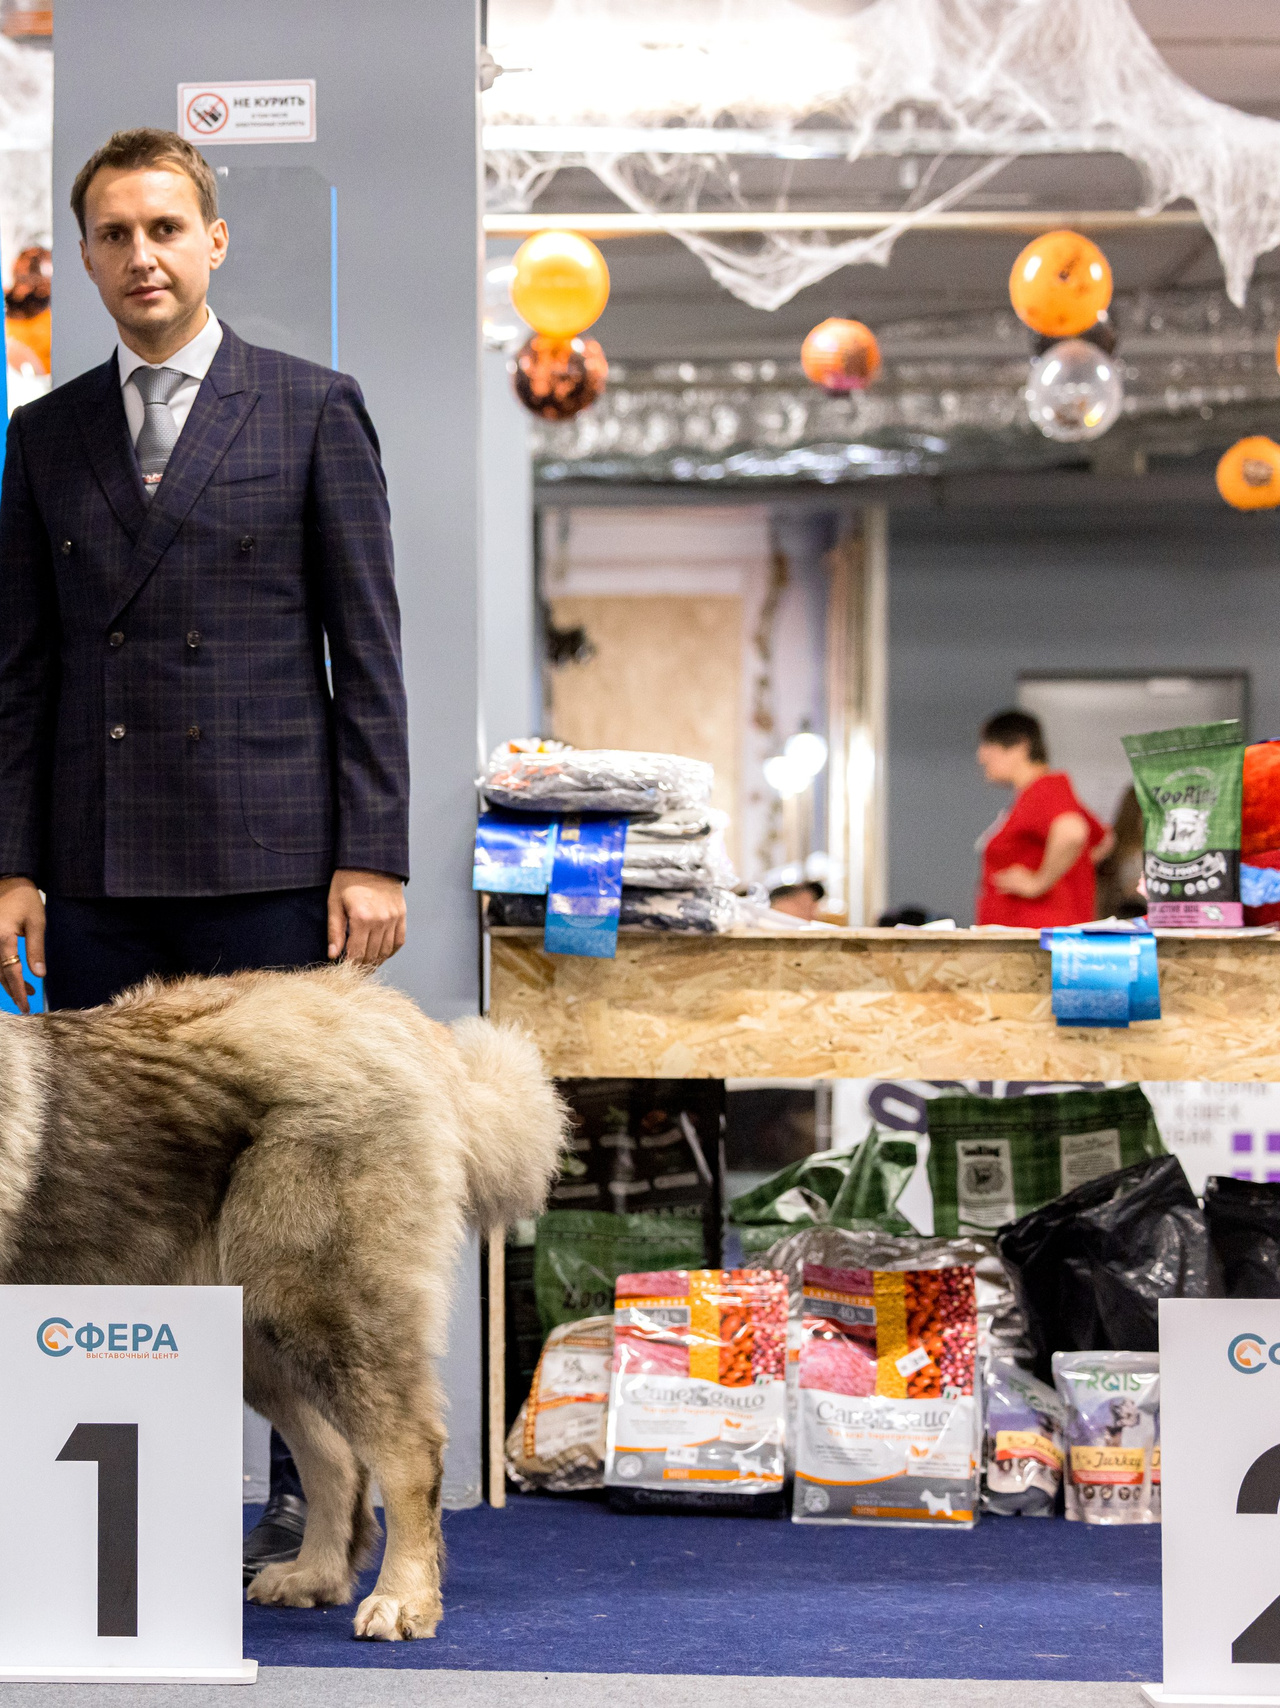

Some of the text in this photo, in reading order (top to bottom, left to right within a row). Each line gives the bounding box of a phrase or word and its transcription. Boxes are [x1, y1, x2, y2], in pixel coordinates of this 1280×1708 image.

[233, 96, 306, 108] НЕ КУРИТЬ
[36, 1316, 179, 1358] СФЕРА
[86, 1351, 179, 1360] ВЫСТАВОЧНЫЙ ЦЕНТР
[55, 1423, 138, 1636] 1
